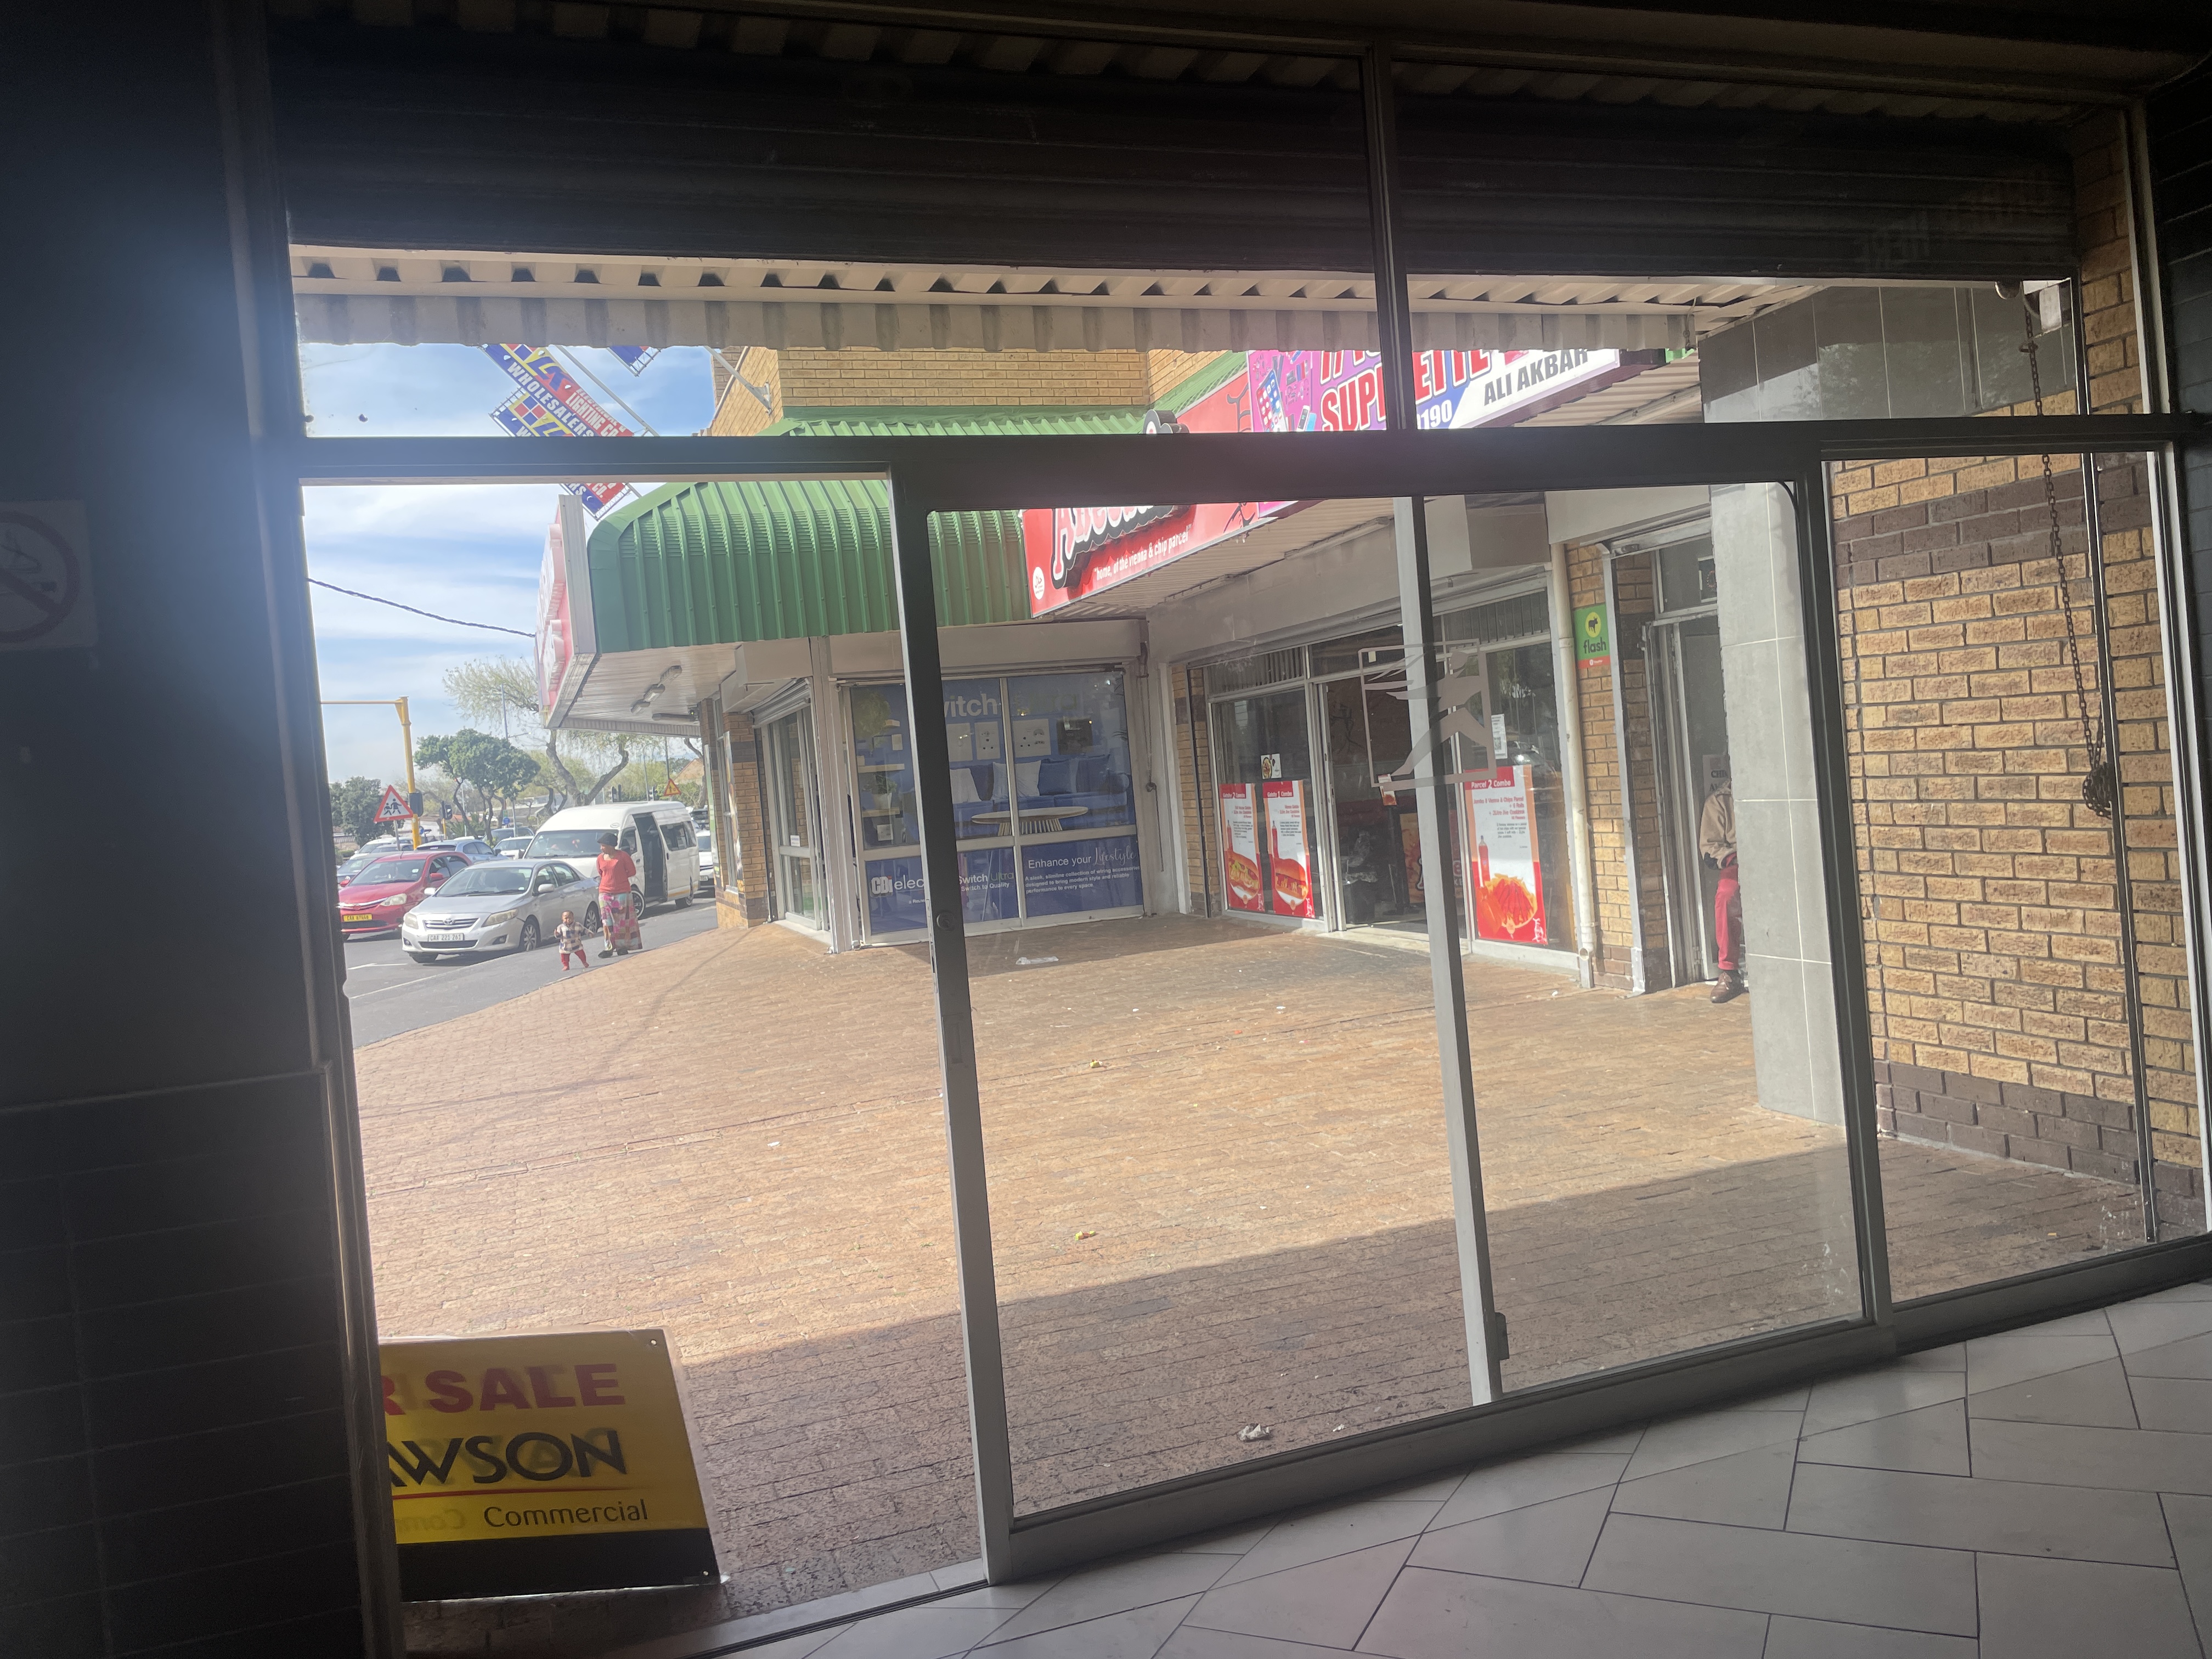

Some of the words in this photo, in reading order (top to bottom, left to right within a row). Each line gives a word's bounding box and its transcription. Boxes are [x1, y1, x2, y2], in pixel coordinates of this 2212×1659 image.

[1483, 372, 1513, 406] ALI
[1516, 348, 1588, 392] AKBAR
[507, 362, 594, 437] WHOLESALERS
[566, 392, 606, 430] LIGHTING
[601, 424, 619, 437] CO
[1418, 399, 1453, 429] 190
[1113, 557, 1119, 574] of
[1119, 555, 1128, 571] the
[1129, 549, 1147, 567] vienna
[1148, 543, 1154, 558] &
[1154, 537, 1167, 556] chip
[1583, 636, 1607, 654] flash
[944, 693, 998, 718] itch
[1488, 780, 1492, 788] 2
[1028, 858, 1069, 869] Enhance
[1071, 856, 1092, 867] your
[1092, 845, 1136, 866] Lifestyle
[894, 874, 925, 890] elec
[425, 1363, 625, 1414] SALE
[484, 1498, 648, 1528] Commercial
